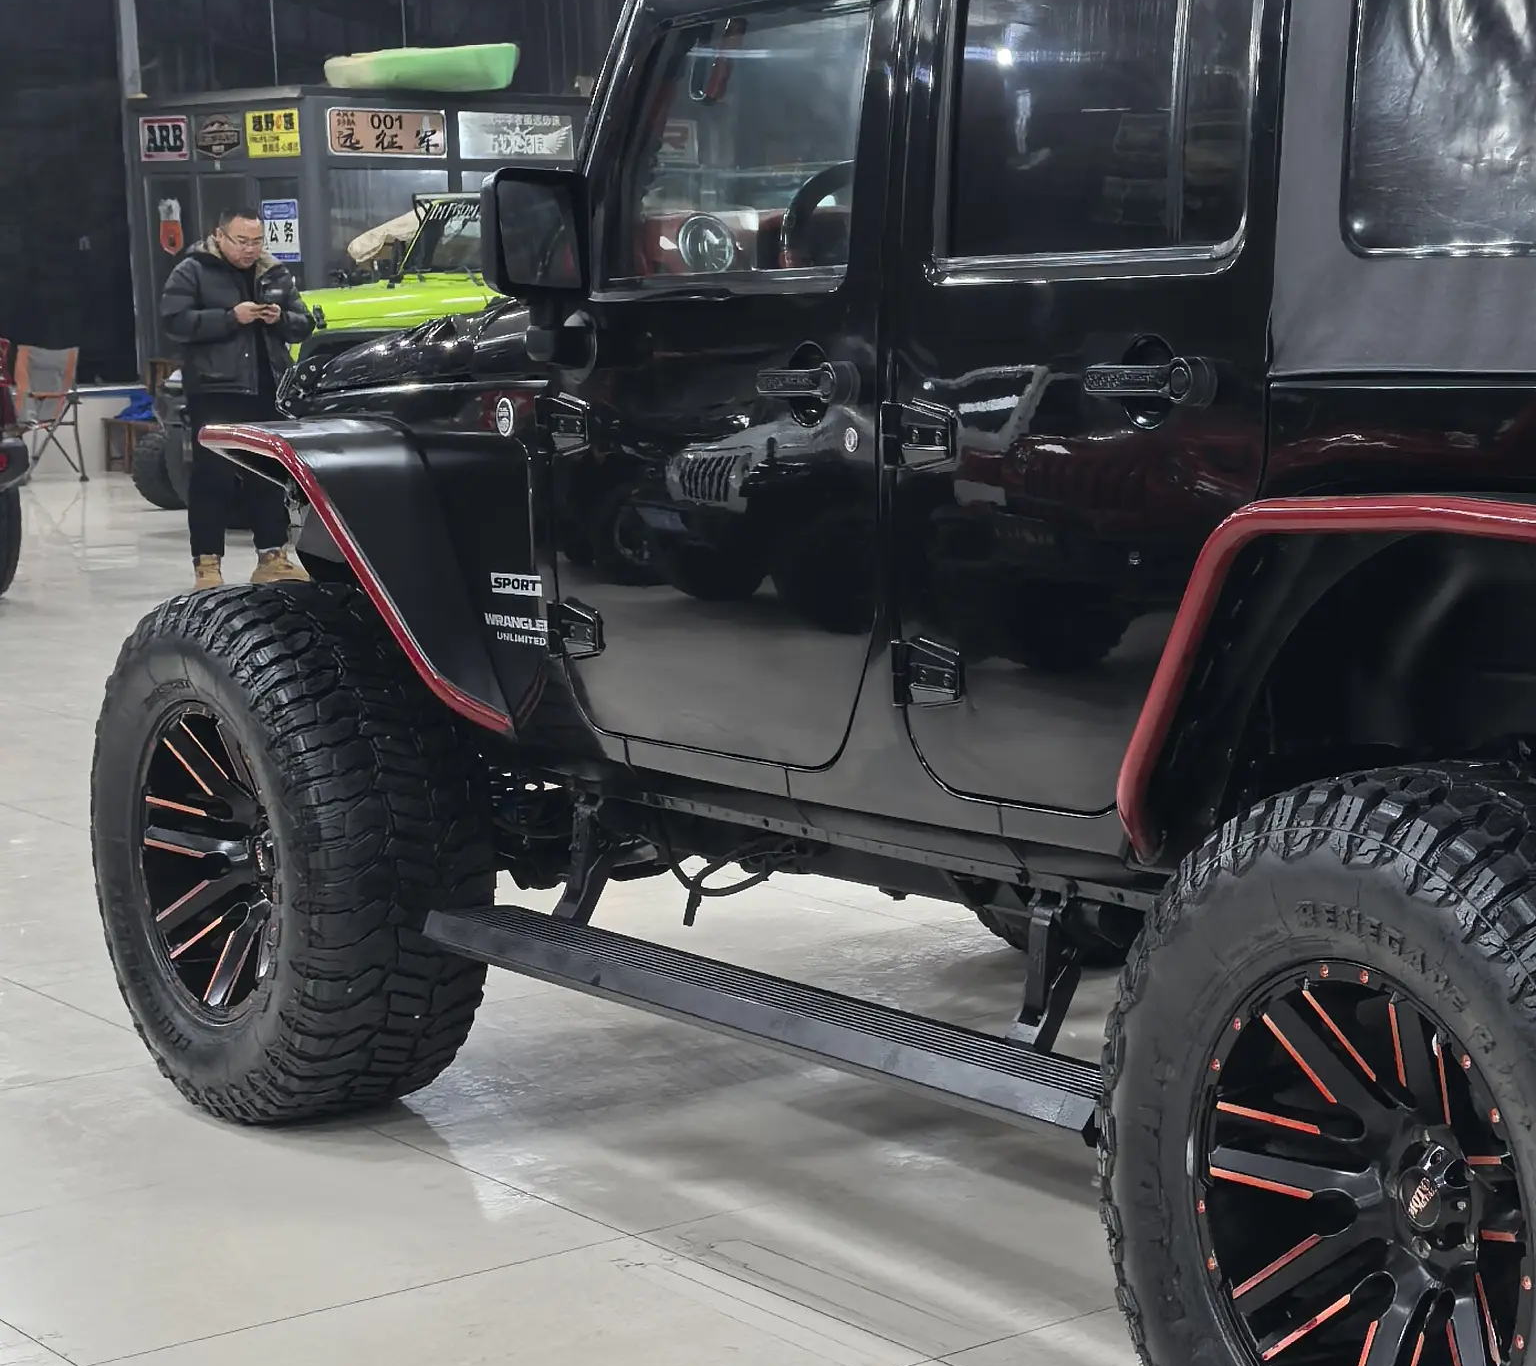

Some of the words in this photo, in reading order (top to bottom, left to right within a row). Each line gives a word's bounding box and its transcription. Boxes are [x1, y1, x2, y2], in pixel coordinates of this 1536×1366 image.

[370, 114, 403, 130] 001
[146, 124, 184, 152] ARB
[268, 220, 294, 244] 公务
[493, 576, 537, 592] SPORT
[496, 631, 547, 646] UNLIMITED
